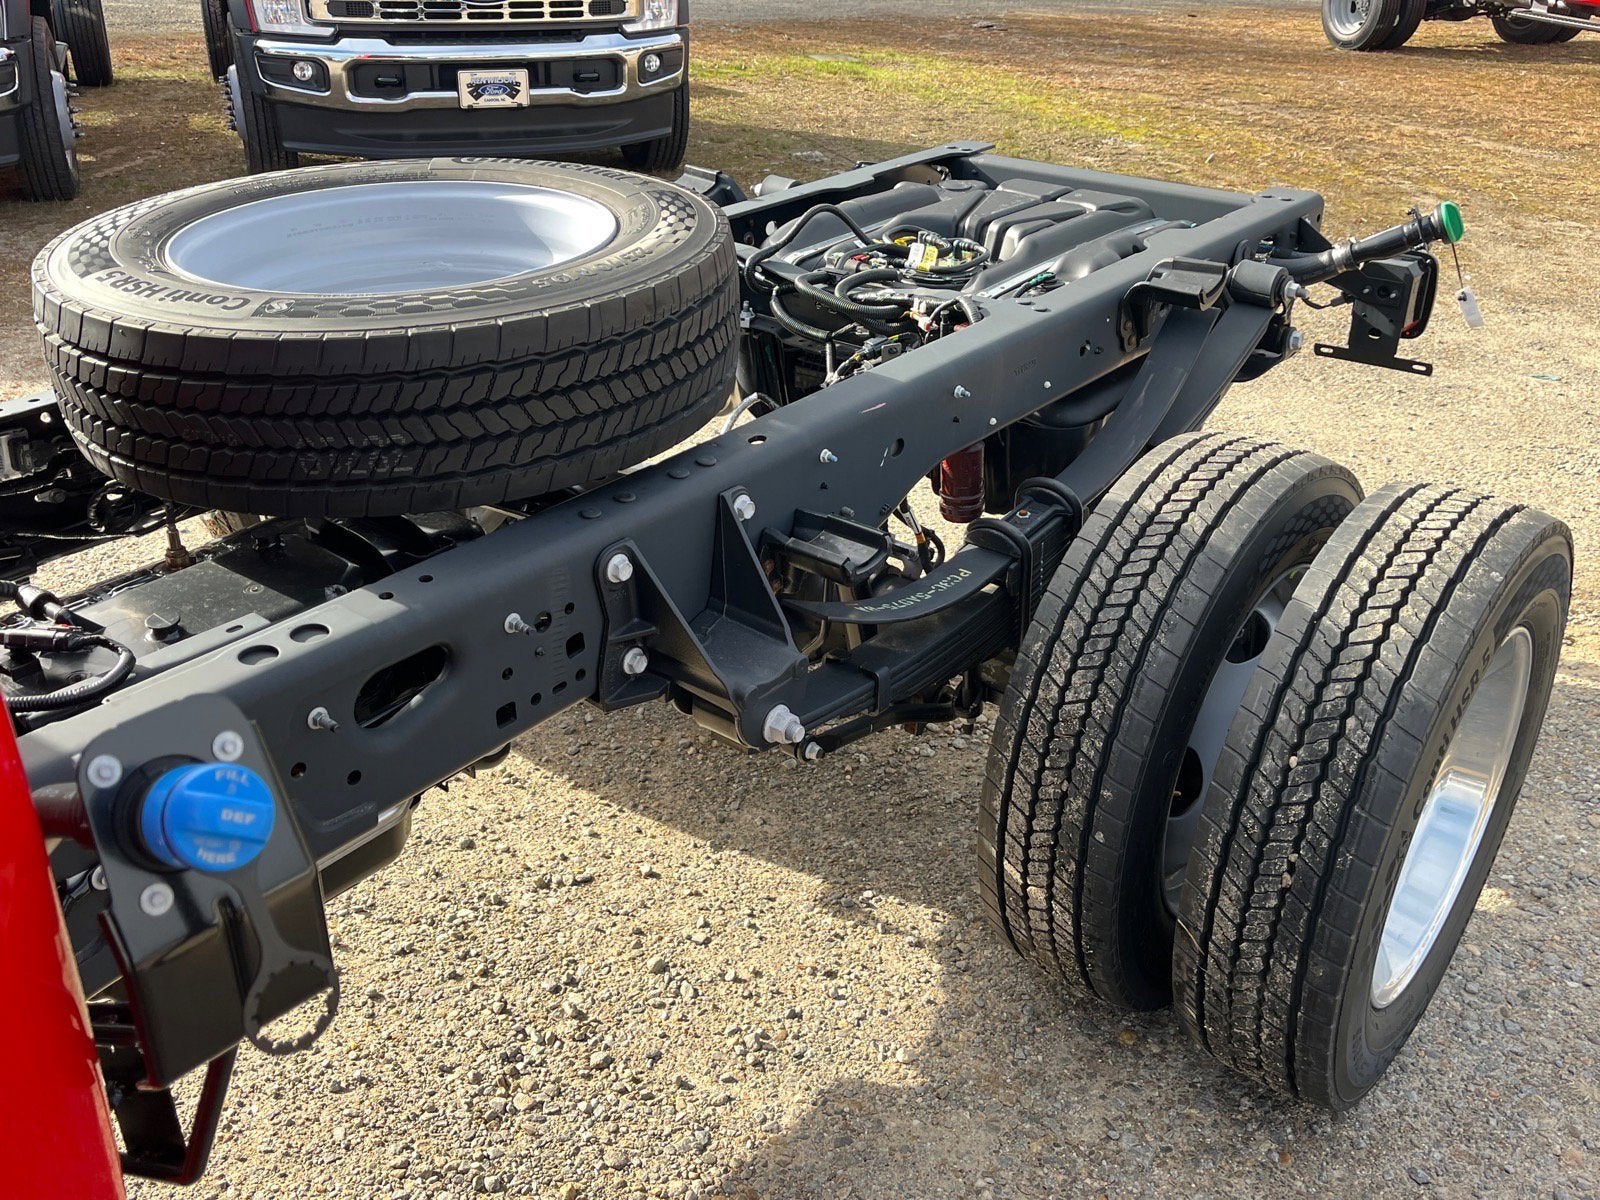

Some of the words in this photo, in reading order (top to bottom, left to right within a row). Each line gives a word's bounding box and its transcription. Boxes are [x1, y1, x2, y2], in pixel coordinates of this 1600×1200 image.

[158, 291, 251, 311] Conti
[215, 769, 250, 788] FILL
[1412, 733, 1451, 821] Conti
[221, 808, 256, 826] DEF
[197, 848, 238, 865] HERE
